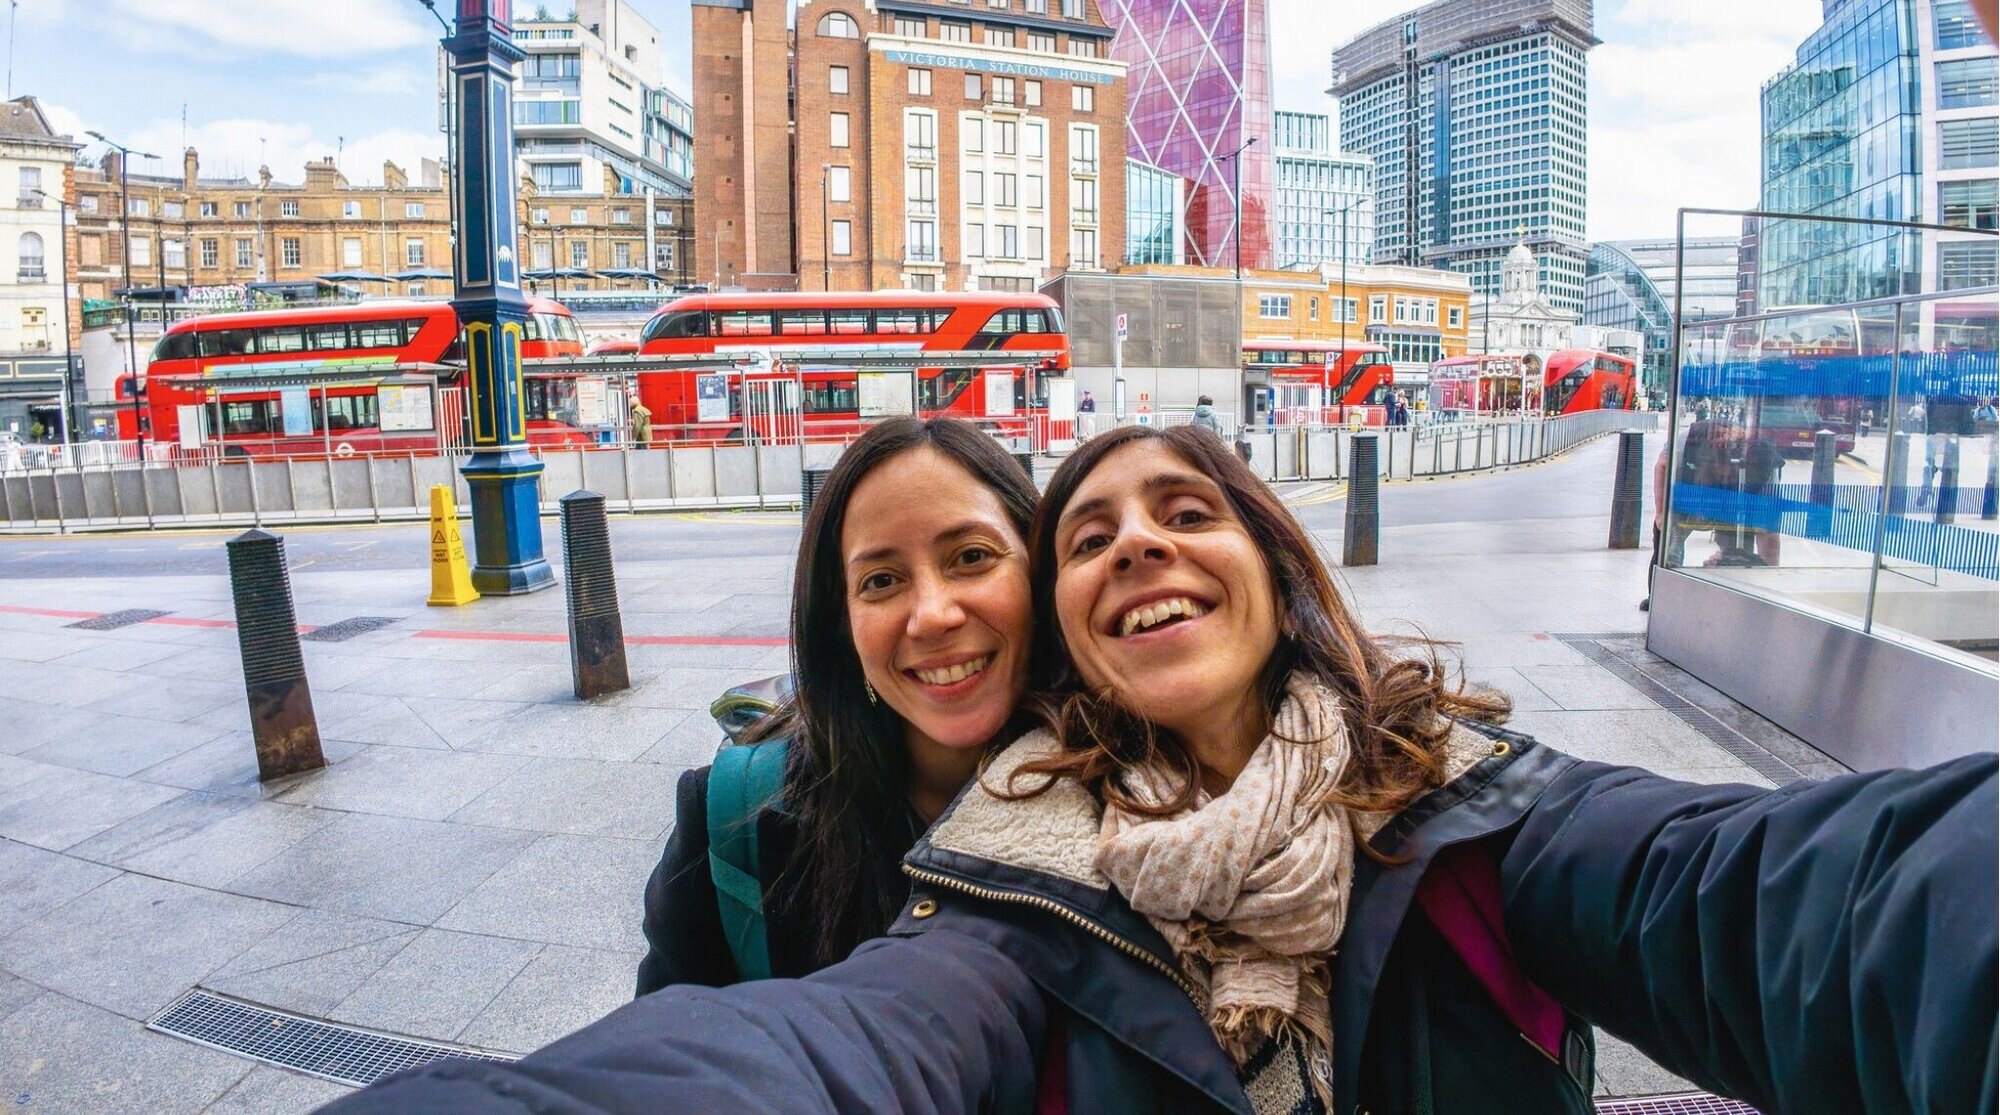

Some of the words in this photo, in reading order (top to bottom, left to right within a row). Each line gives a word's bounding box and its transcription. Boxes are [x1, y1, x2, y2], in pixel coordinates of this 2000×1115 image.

[897, 52, 976, 69] VICTORIA
[989, 61, 1050, 77] STATION
[1059, 70, 1105, 85] HOUSE
